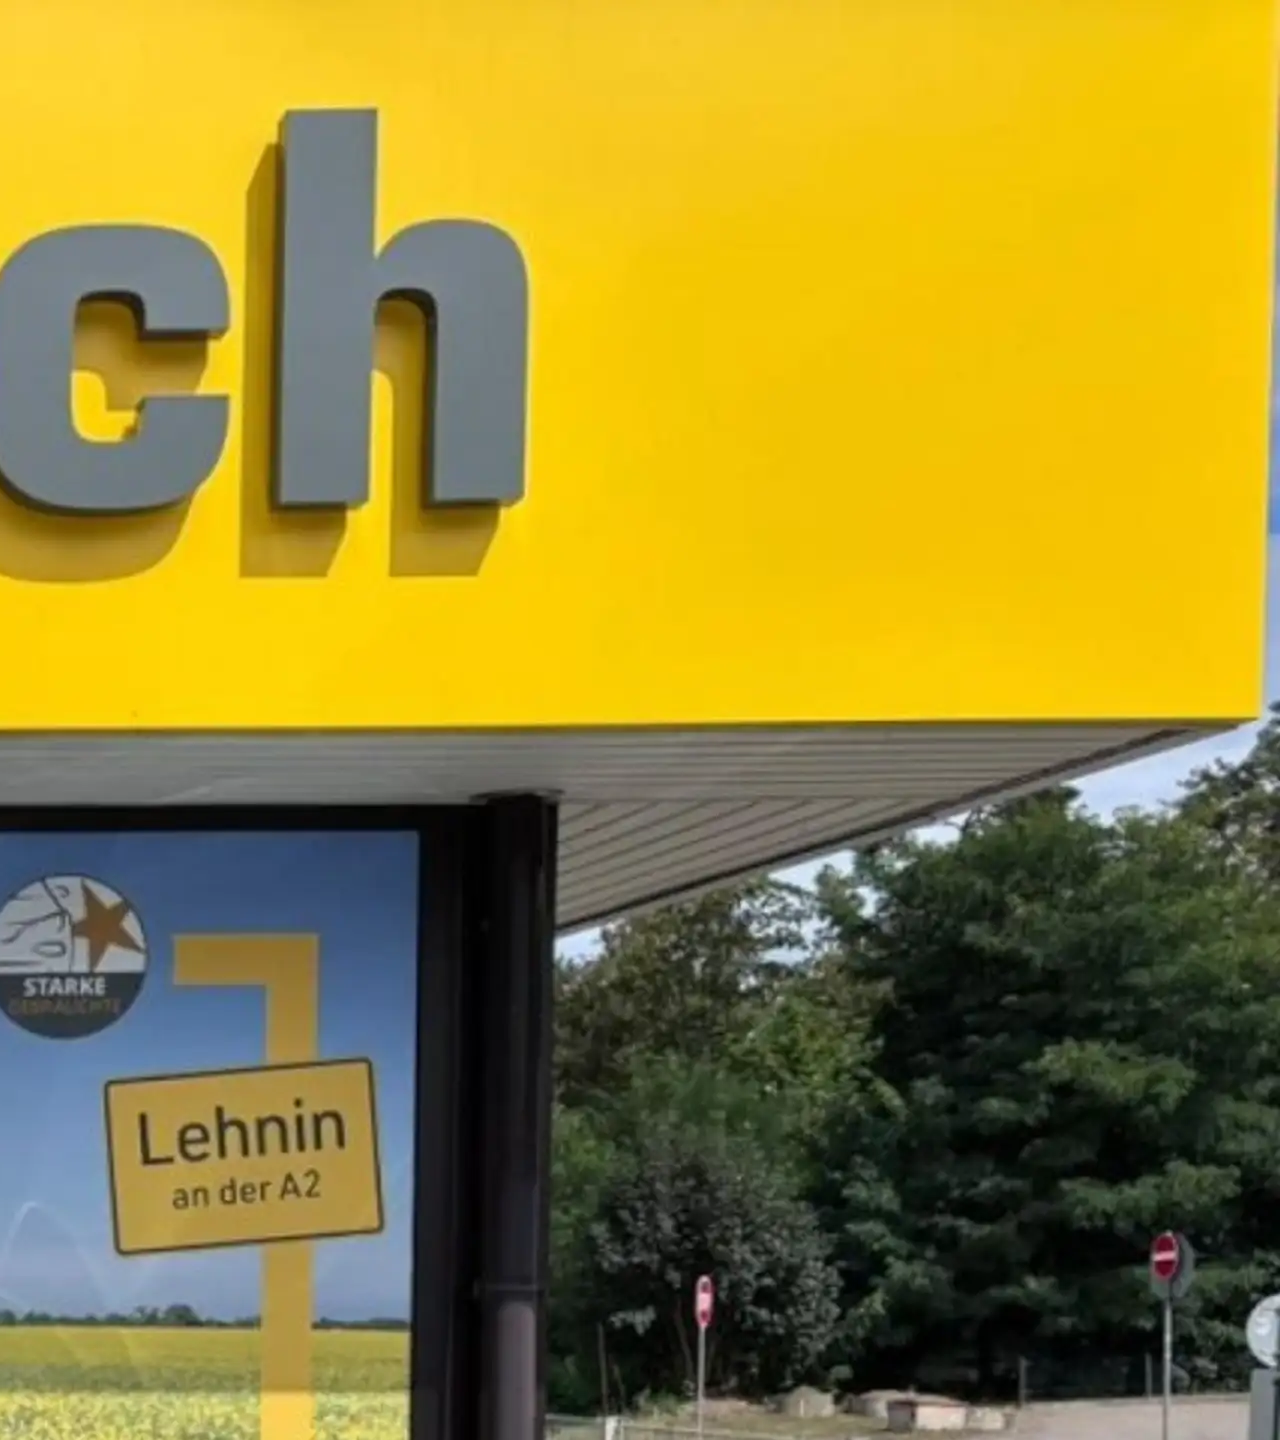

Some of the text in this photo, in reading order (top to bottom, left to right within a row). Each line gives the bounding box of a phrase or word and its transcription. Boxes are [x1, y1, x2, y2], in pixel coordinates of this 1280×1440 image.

[22, 976, 107, 998] STARKE
[138, 1097, 346, 1167] Lehnin
[172, 1168, 321, 1210] an der A2
